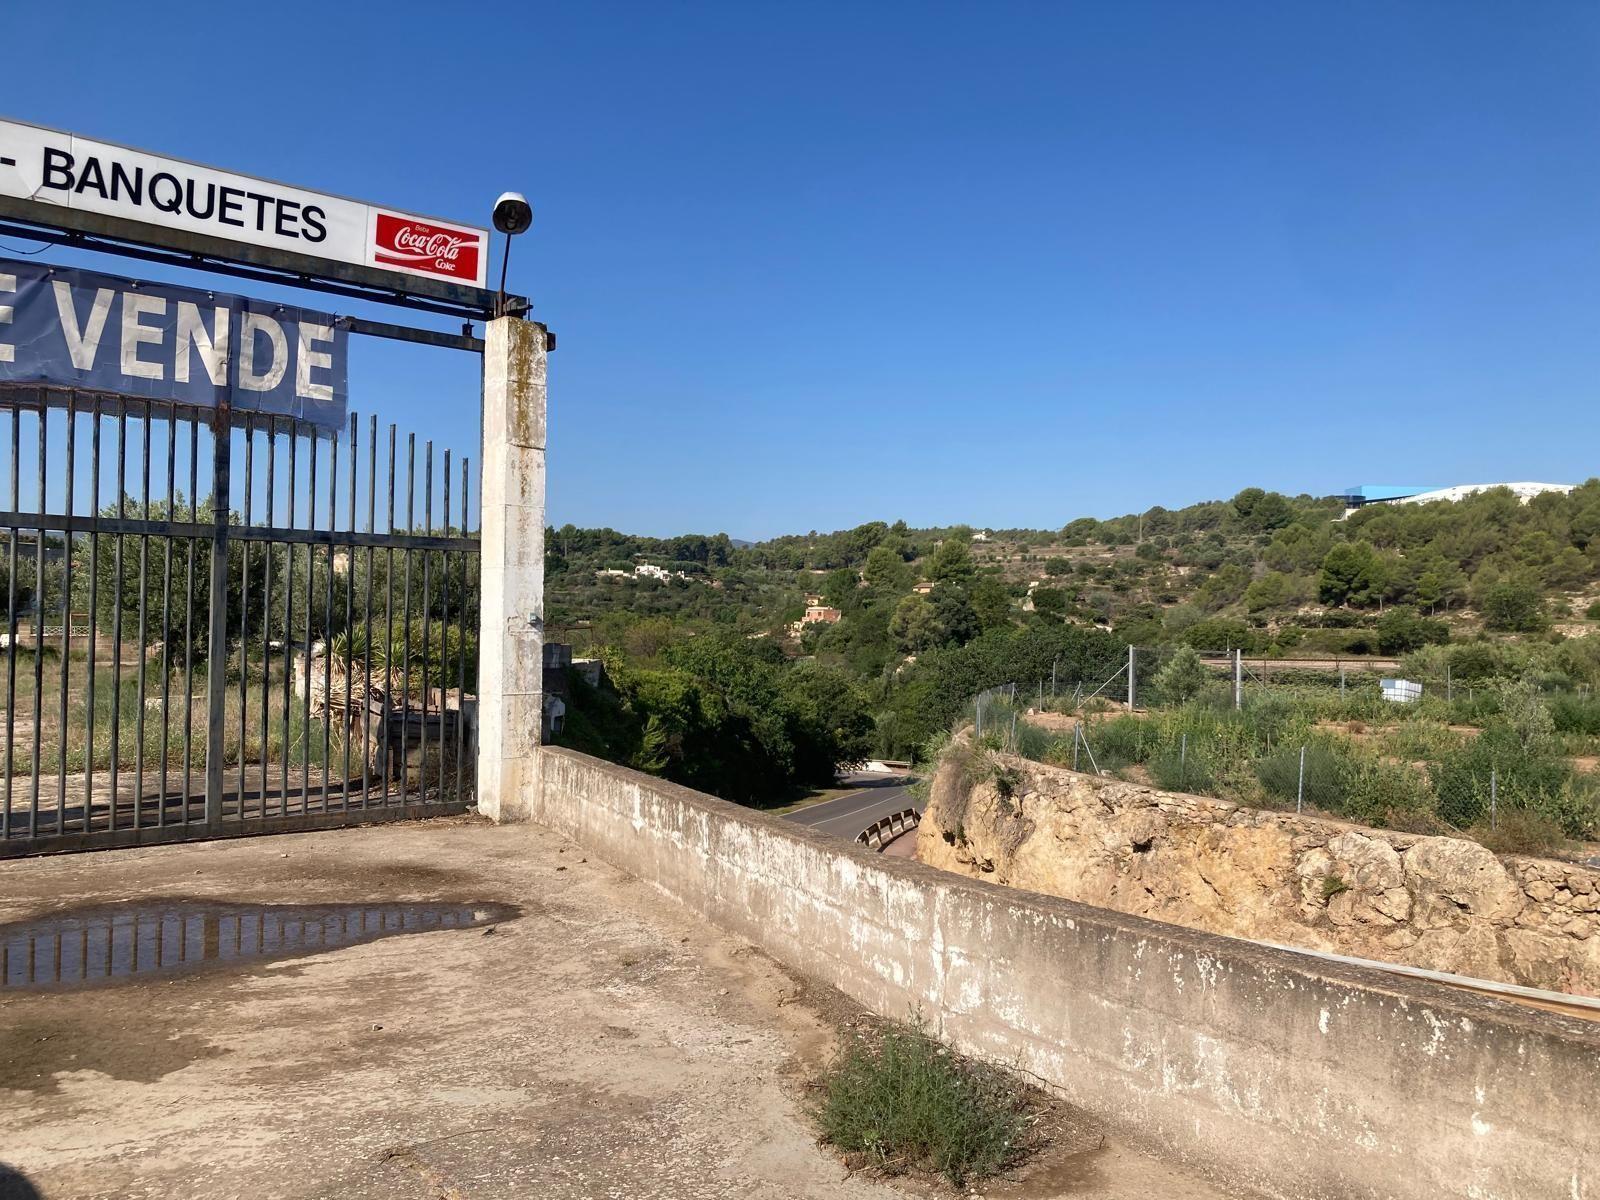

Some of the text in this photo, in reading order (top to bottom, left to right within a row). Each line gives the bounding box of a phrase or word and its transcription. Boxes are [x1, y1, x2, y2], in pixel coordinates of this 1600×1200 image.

[42, 146, 327, 243] BANQUETES
[394, 226, 462, 260] Coca-Cola
[434, 259, 456, 271] Coke
[52, 280, 336, 401] VENDE
